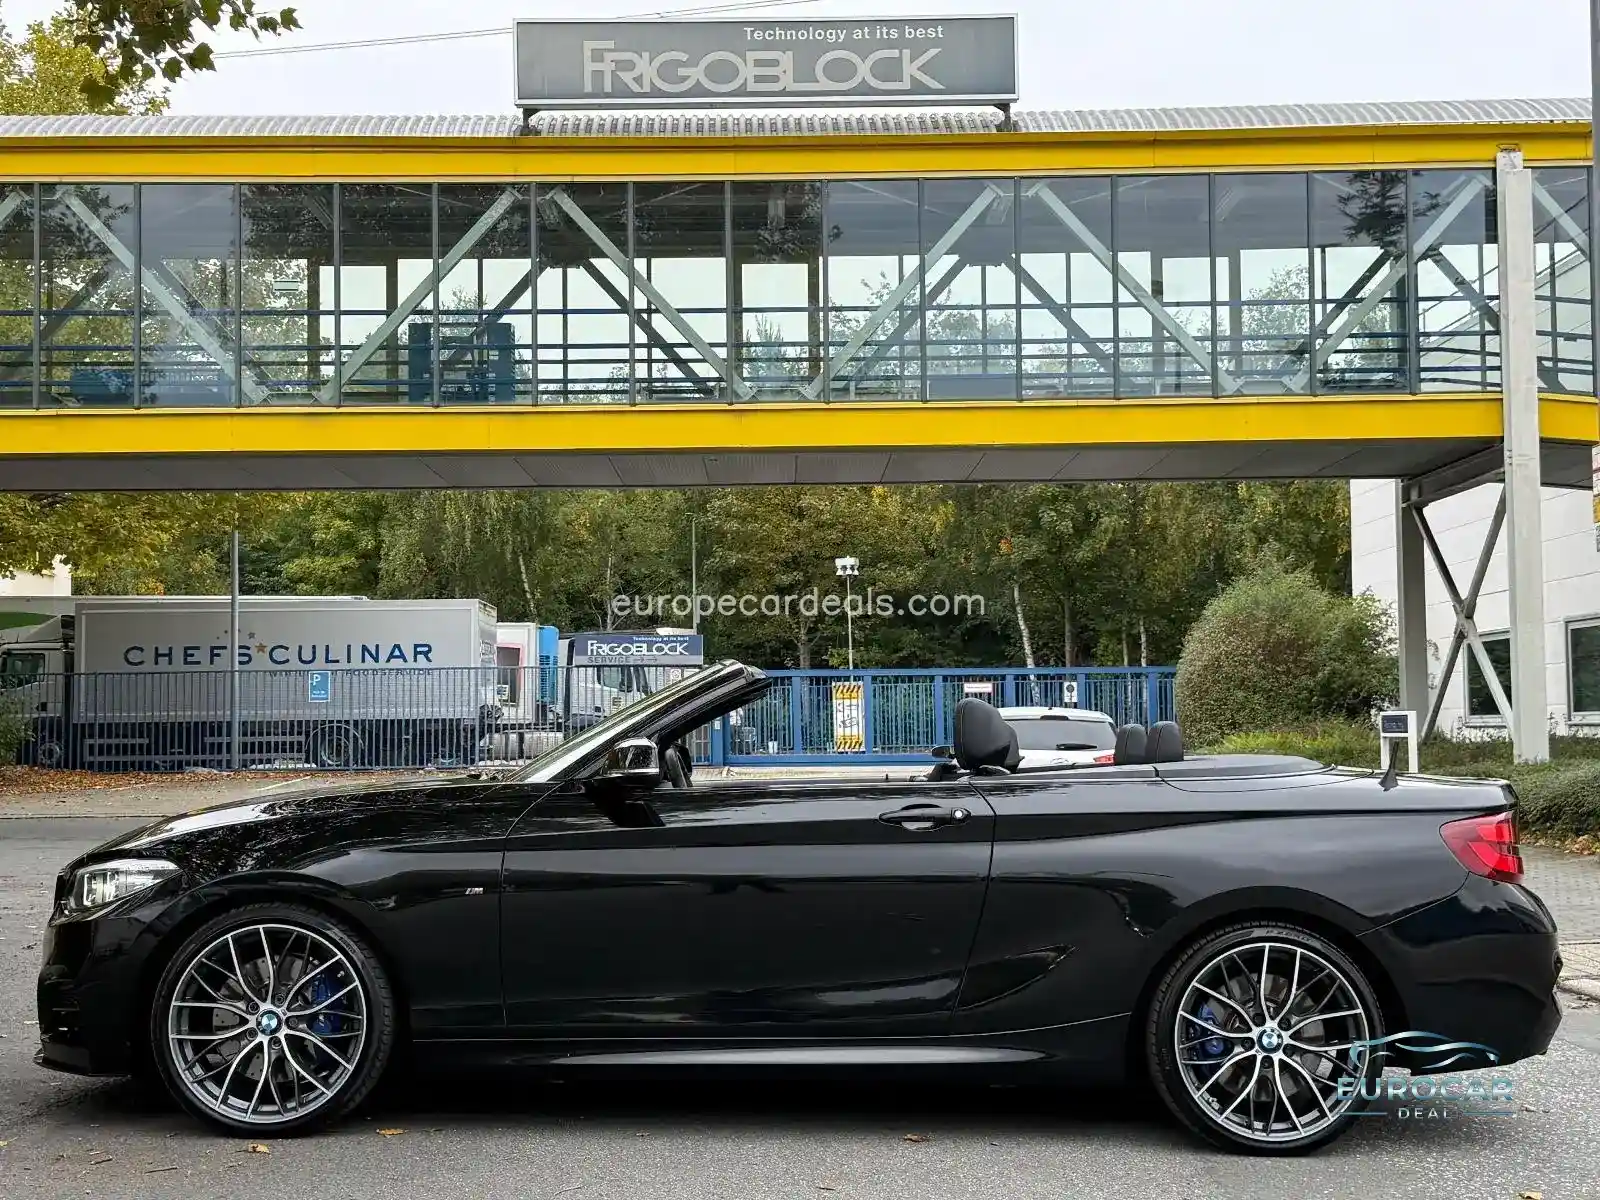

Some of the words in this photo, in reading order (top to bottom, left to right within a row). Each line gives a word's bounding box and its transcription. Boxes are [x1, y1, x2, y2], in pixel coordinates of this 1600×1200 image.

[744, 27, 847, 42] Technology
[852, 27, 870, 39] at
[876, 26, 899, 39] its
[904, 25, 944, 38] best
[582, 39, 946, 93] FRIGOBLOCK
[123, 645, 253, 666] CHEFS
[268, 644, 433, 664] CULINAR
[587, 640, 689, 656] FRIGOBLOCK
